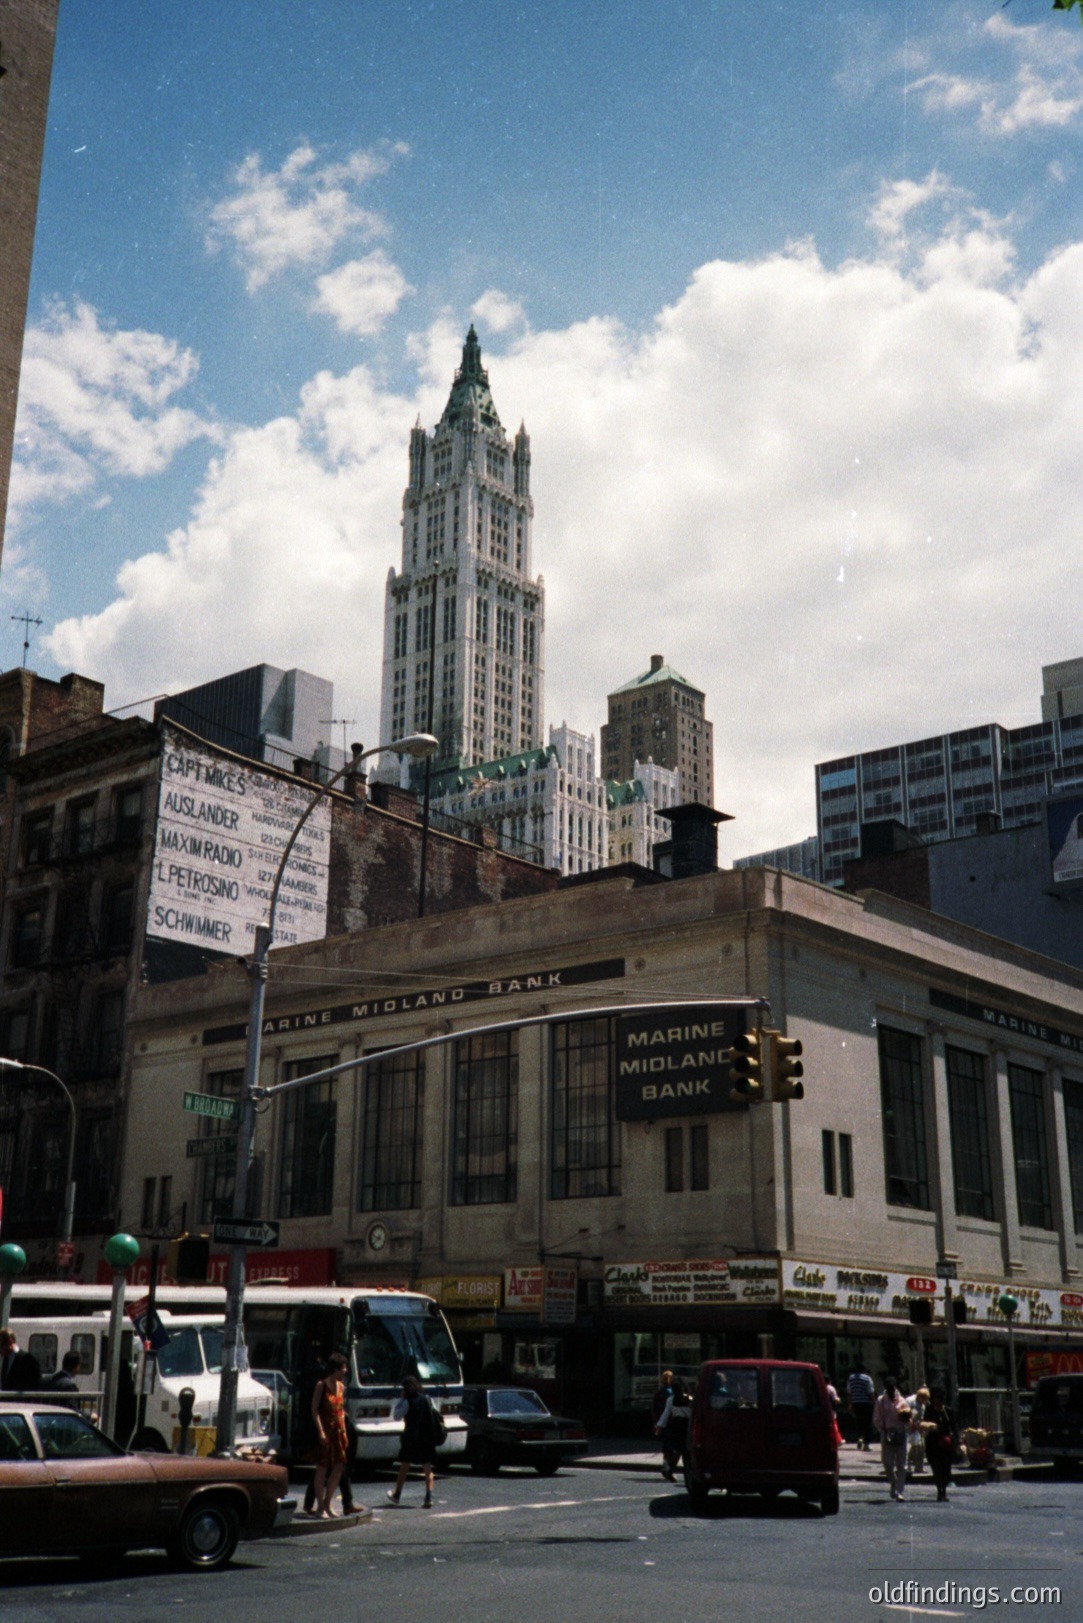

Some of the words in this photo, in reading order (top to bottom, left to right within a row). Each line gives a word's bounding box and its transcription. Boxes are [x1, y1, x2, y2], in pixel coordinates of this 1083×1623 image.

[167, 752, 202, 781] CAPT
[164, 791, 239, 831] AUSLANDER
[160, 828, 202, 856] MAXIM
[203, 841, 242, 869] RADIO
[258, 869, 272, 883] 127
[265, 852, 317, 876] ELECRONICS
[168, 864, 239, 901] PETROSINO
[154, 905, 232, 943] SCHWIMMER
[274, 929, 298, 944] STATE
[247, 1009, 332, 1035] ARINE
[352, 988, 464, 1017] MIDLAND
[489, 972, 562, 994] BANK
[627, 1021, 725, 1048] MARINE
[983, 1008, 1048, 1040] MARINE
[185, 1094, 192, 1109] W
[642, 1078, 712, 1101] BANK
[219, 1225, 238, 1238] ONE
[249, 1227, 269, 1239] WAY
[249, 1265, 300, 1283] EXPRESS
[912, 1279, 932, 1290] 132
[456, 1281, 500, 1296] FLORIST
